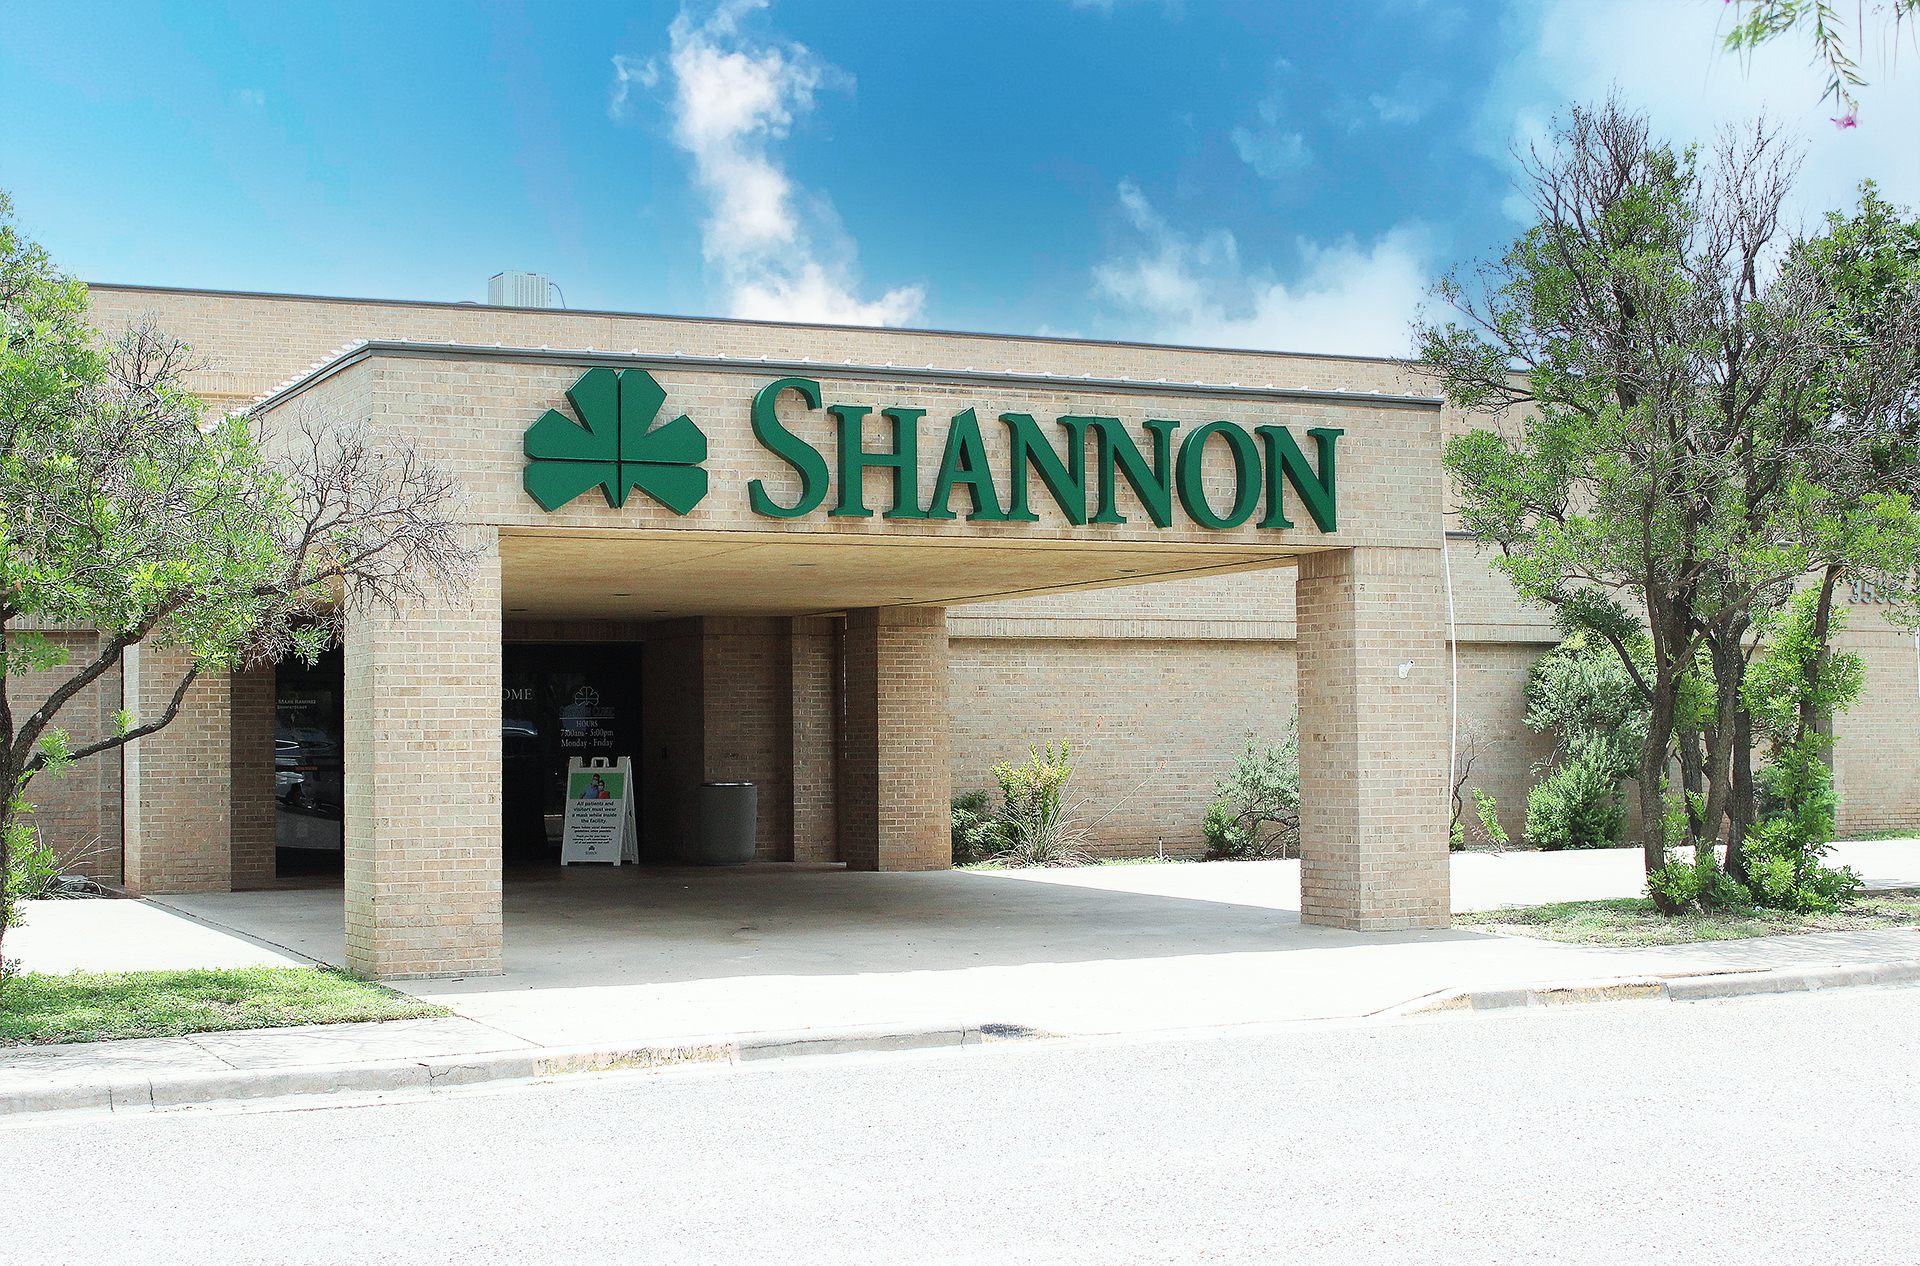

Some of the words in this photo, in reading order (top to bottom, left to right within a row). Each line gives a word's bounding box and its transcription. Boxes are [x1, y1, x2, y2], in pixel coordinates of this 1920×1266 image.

[747, 375, 1345, 533] SHANNON
[576, 720, 599, 728] HOURS
[560, 728, 585, 737] 7:00am
[589, 728, 614, 738] 5:00pm
[560, 738, 588, 749] Monday
[593, 738, 614, 748] Friday
